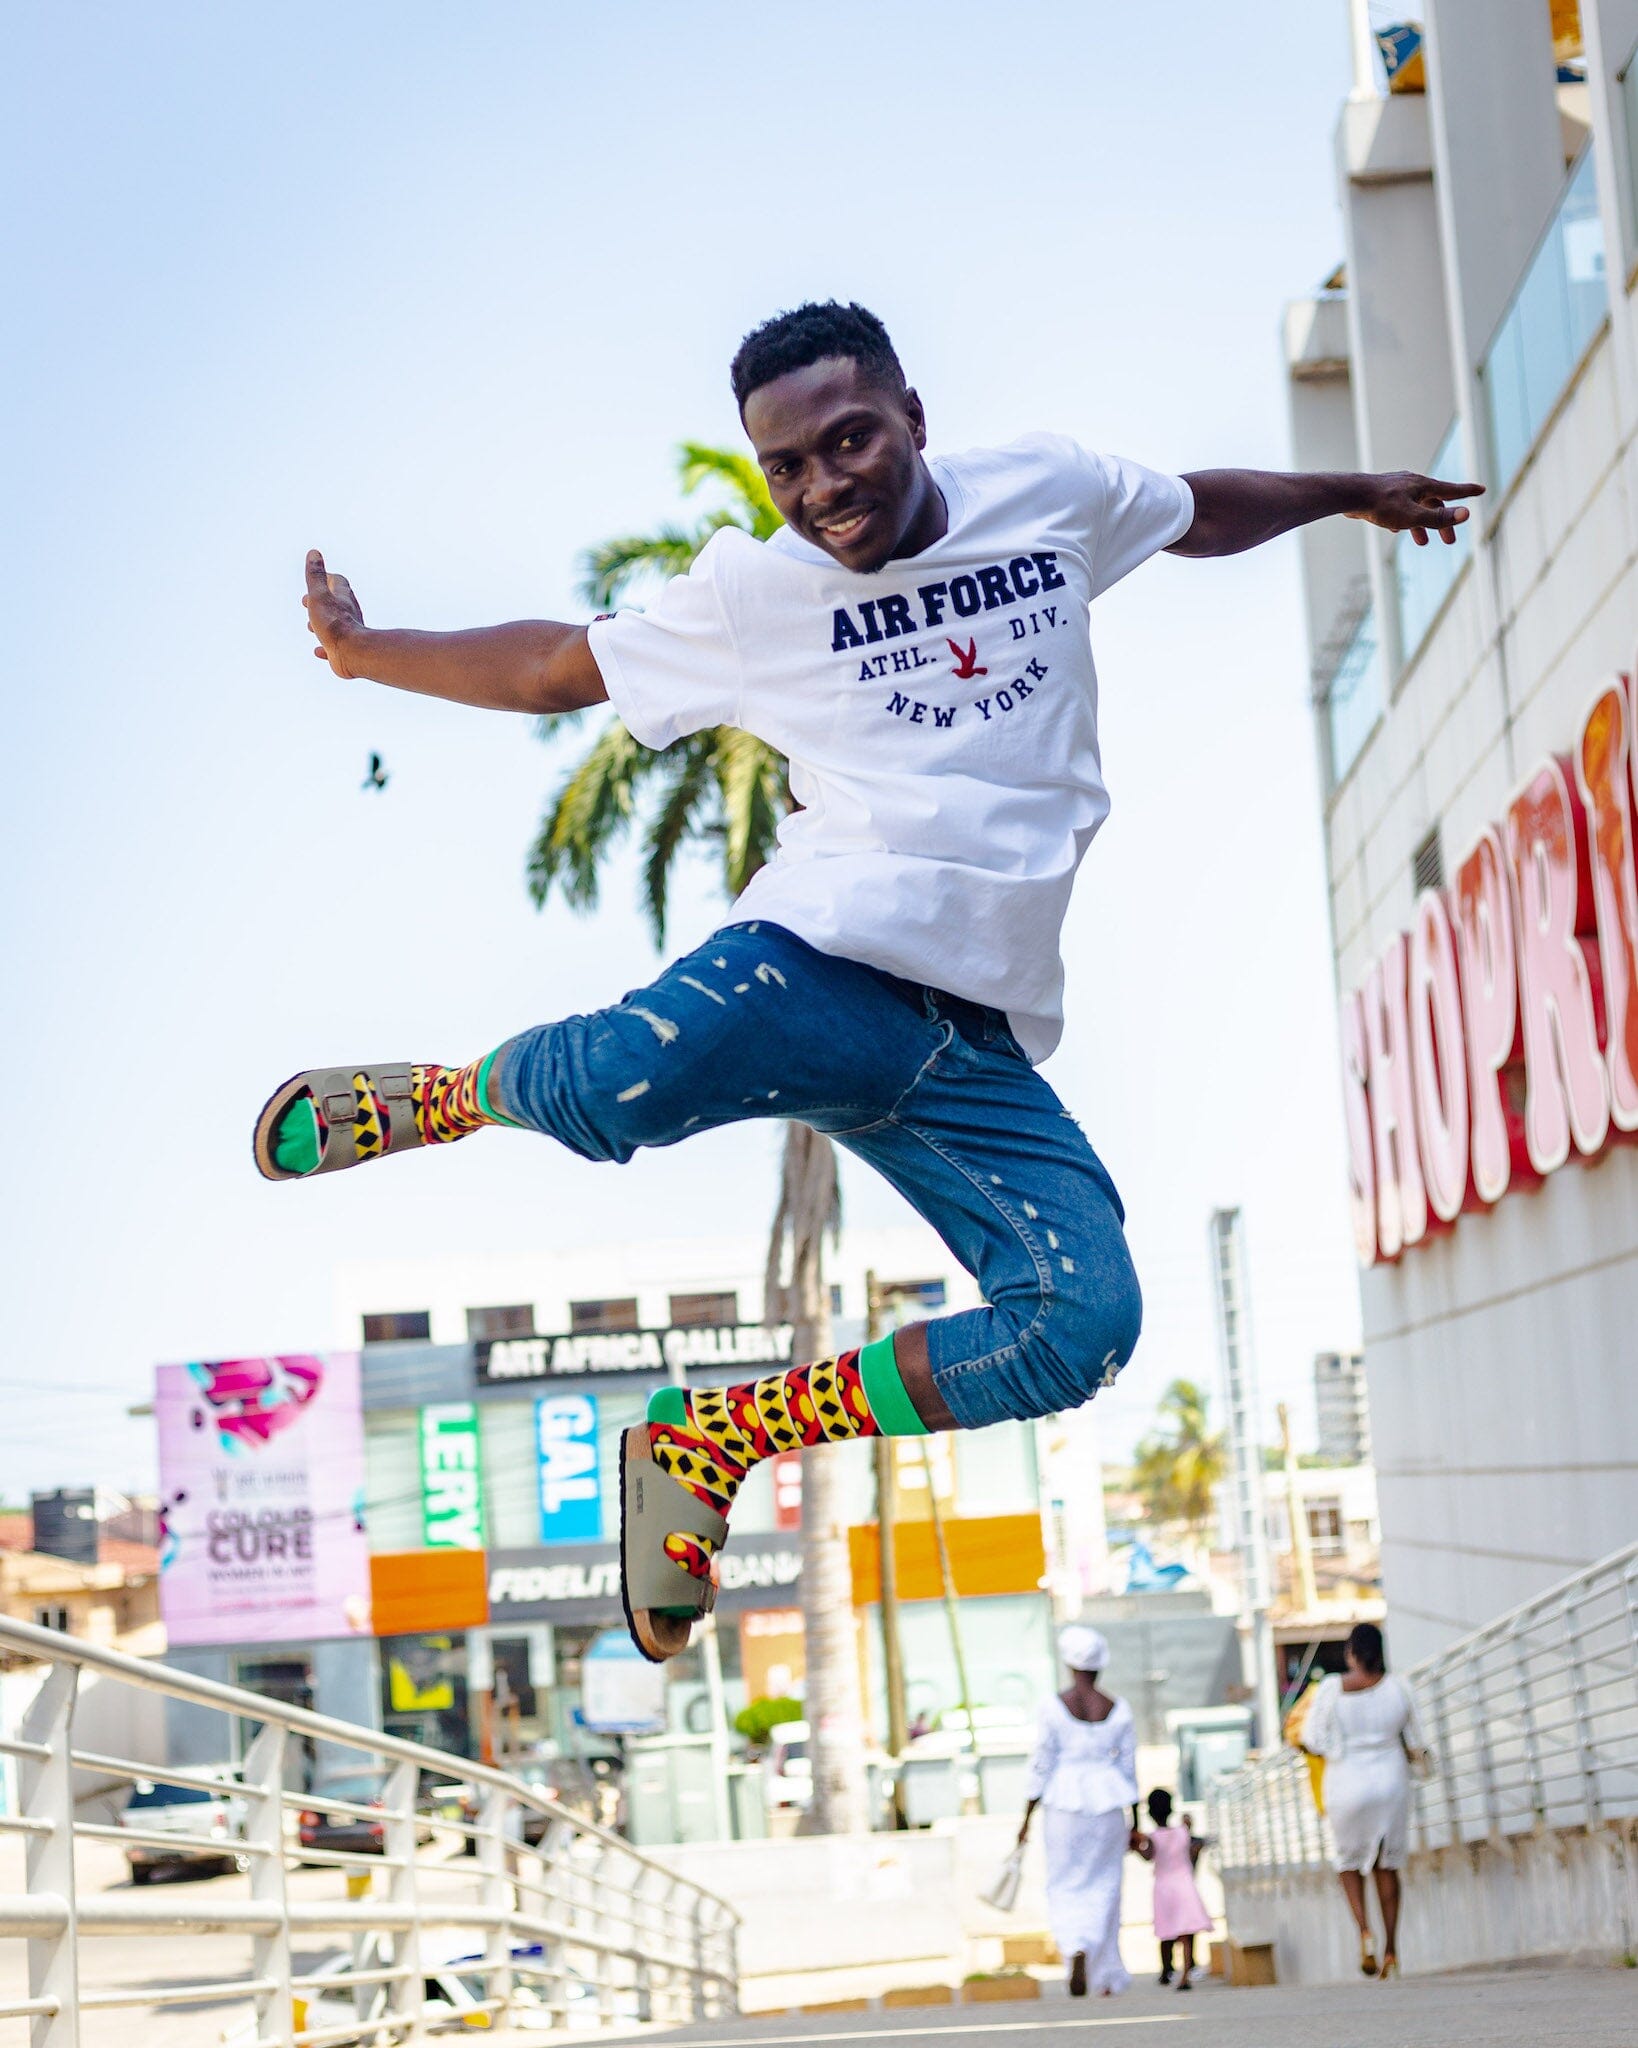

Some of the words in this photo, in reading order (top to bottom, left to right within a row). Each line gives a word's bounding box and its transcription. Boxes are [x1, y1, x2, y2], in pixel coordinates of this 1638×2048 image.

[831, 594, 917, 652] AIR
[917, 552, 1066, 628] FORCE
[858, 647, 937, 681] ATHL.
[1009, 606, 1068, 640] DIV.
[886, 691, 956, 727] NEW
[974, 657, 1048, 721] YORK
[1342, 645, 1638, 1269] SHOPRI
[487, 1340, 550, 1378] ART
[552, 1331, 665, 1375] AFRICA
[662, 1323, 796, 1367] GALLERY
[421, 1402, 483, 1549] LERY
[539, 1396, 598, 1514] GAL
[208, 1528, 313, 1564] CURE
[489, 1561, 622, 1604] FIDELIT
